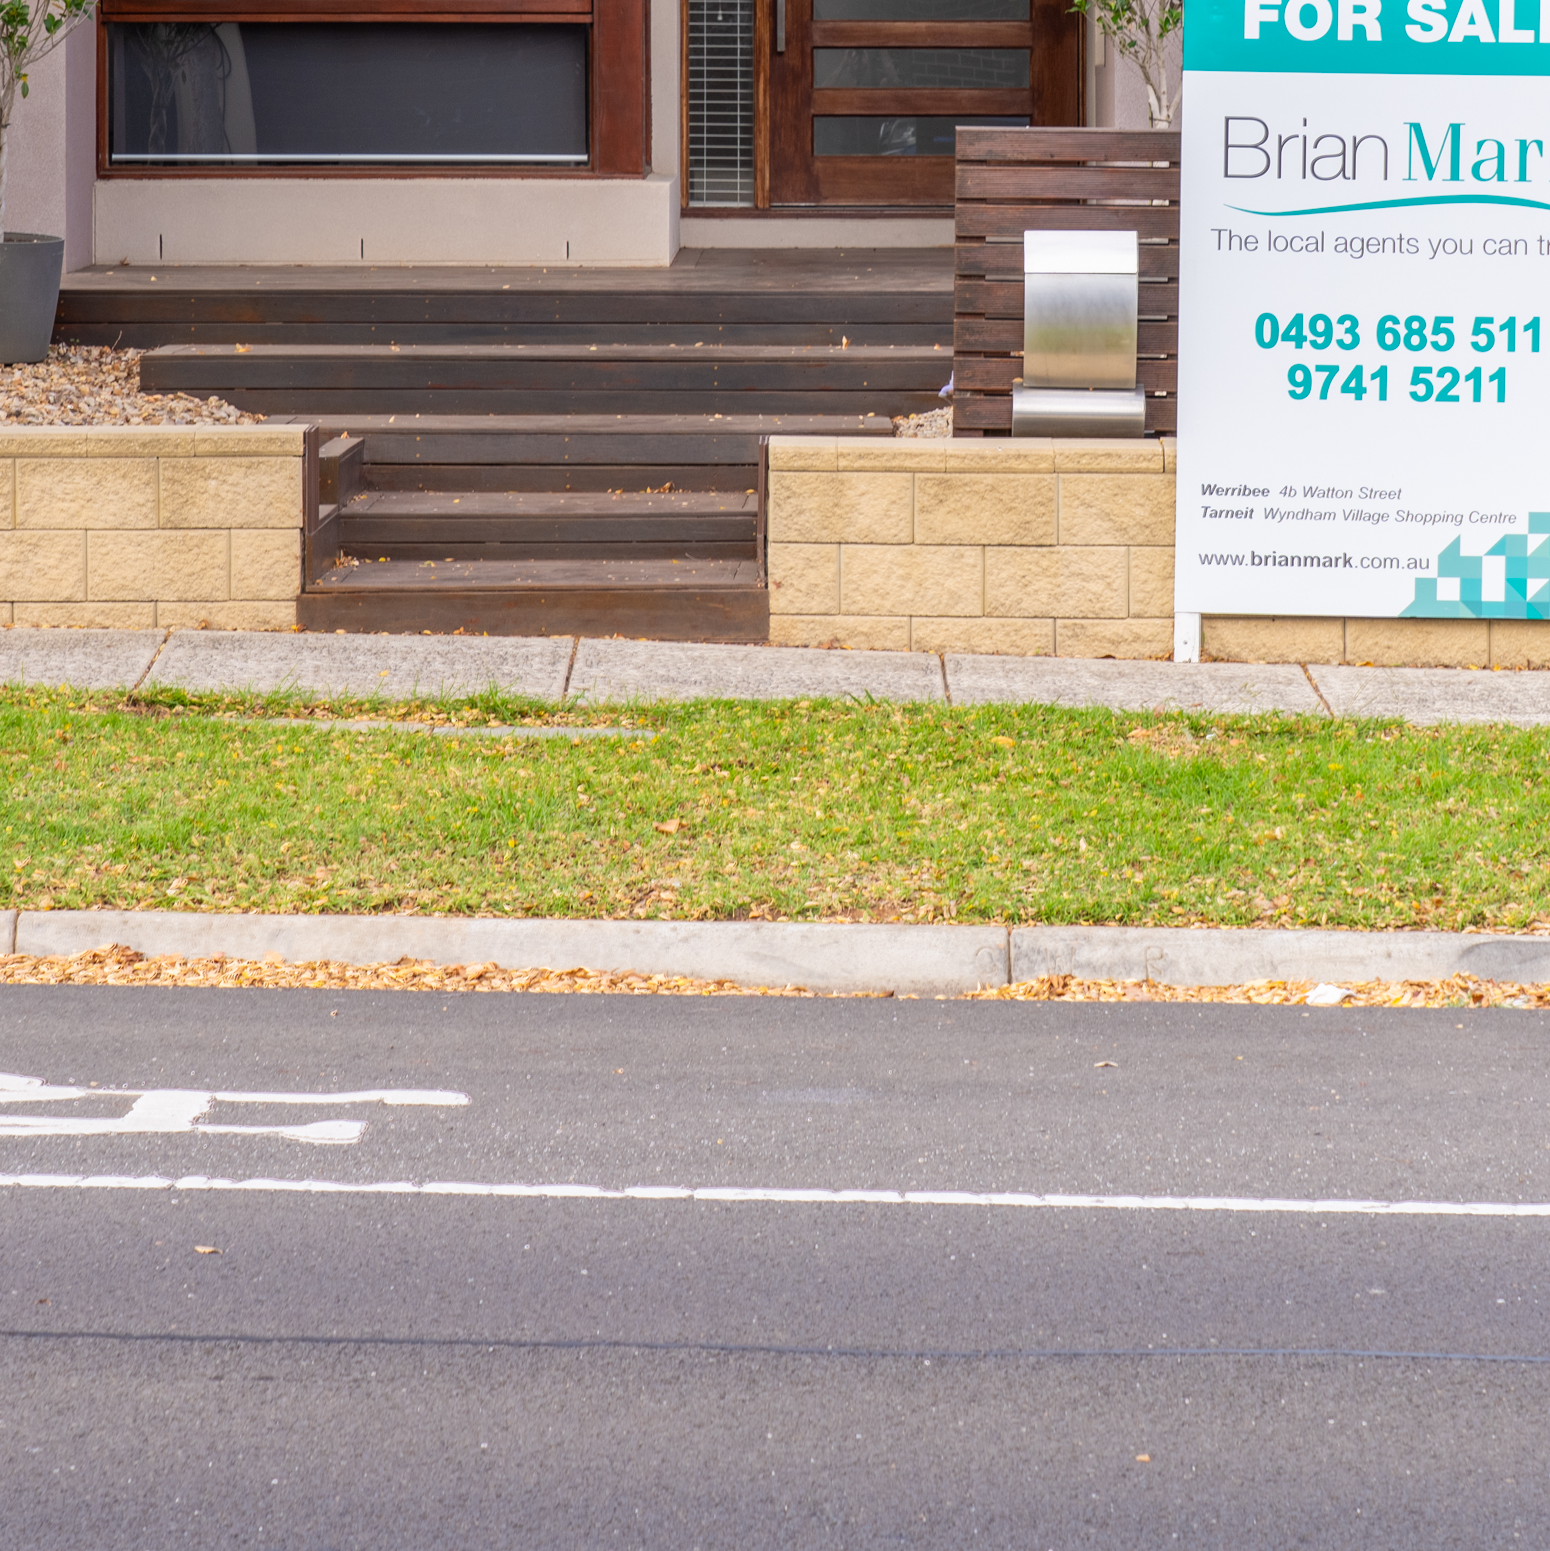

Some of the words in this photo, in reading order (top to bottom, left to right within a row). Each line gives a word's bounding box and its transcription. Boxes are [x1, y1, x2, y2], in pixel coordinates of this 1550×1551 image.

[1223, 115, 1389, 182] Brian
[1210, 228, 1259, 252] The
[1267, 229, 1325, 253] local
[1333, 232, 1420, 260] agents
[1427, 237, 1474, 261] you
[1482, 238, 1528, 256] can
[1254, 312, 1361, 351] 0493
[1375, 314, 1456, 353] 685
[1470, 315, 1541, 353] 511
[1286, 363, 1388, 402] 9741
[1408, 365, 1507, 404] 5211
[1201, 483, 1271, 498] Werribee
[1278, 485, 1298, 498] 4b
[1302, 485, 1354, 499] Watton
[1357, 486, 1402, 501] Street
[1200, 505, 1255, 520] Tarneit
[1263, 507, 1337, 524] Wyndham
[1342, 508, 1390, 526] Village
[1394, 509, 1464, 527] Shopping
[1468, 510, 1517, 525] Centre
[1198, 550, 1430, 570] www.brianmark.com.au
